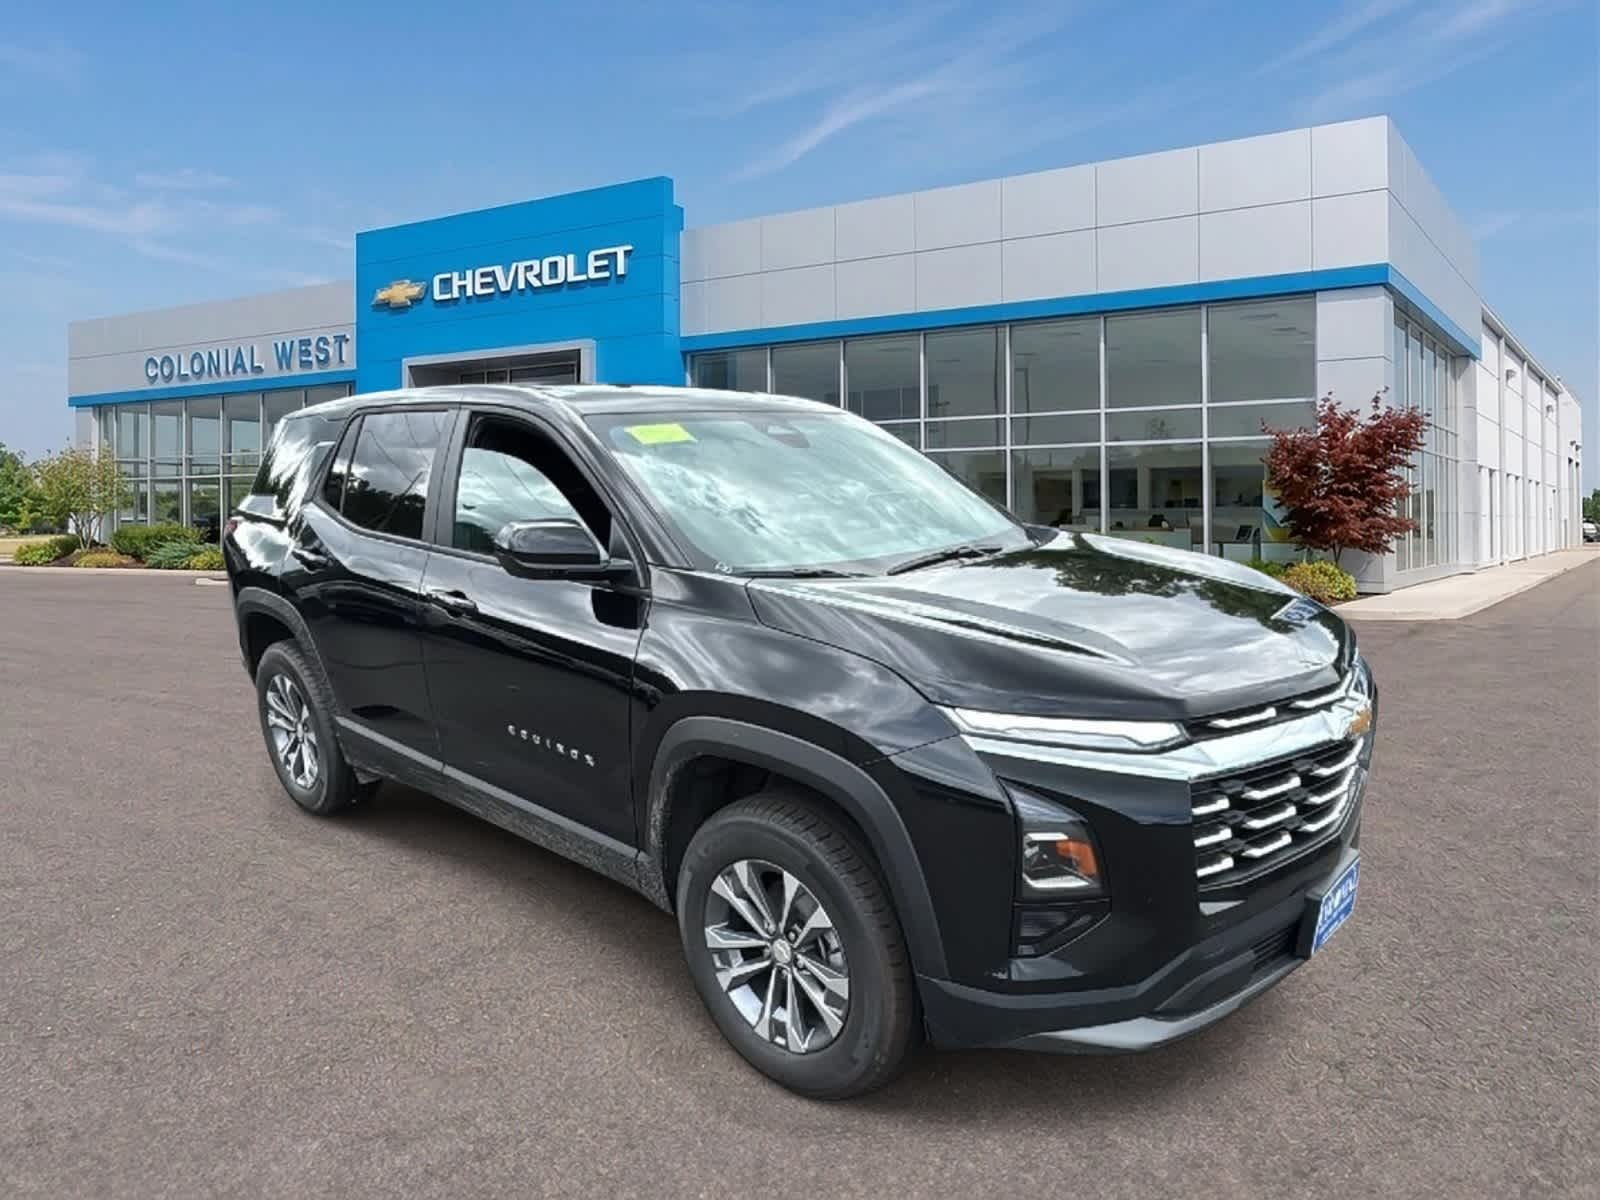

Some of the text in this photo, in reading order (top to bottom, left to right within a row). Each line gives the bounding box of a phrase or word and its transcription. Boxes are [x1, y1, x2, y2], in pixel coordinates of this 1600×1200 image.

[432, 244, 634, 301] CHEVROLET
[144, 333, 350, 385] COLONIAL WEST
